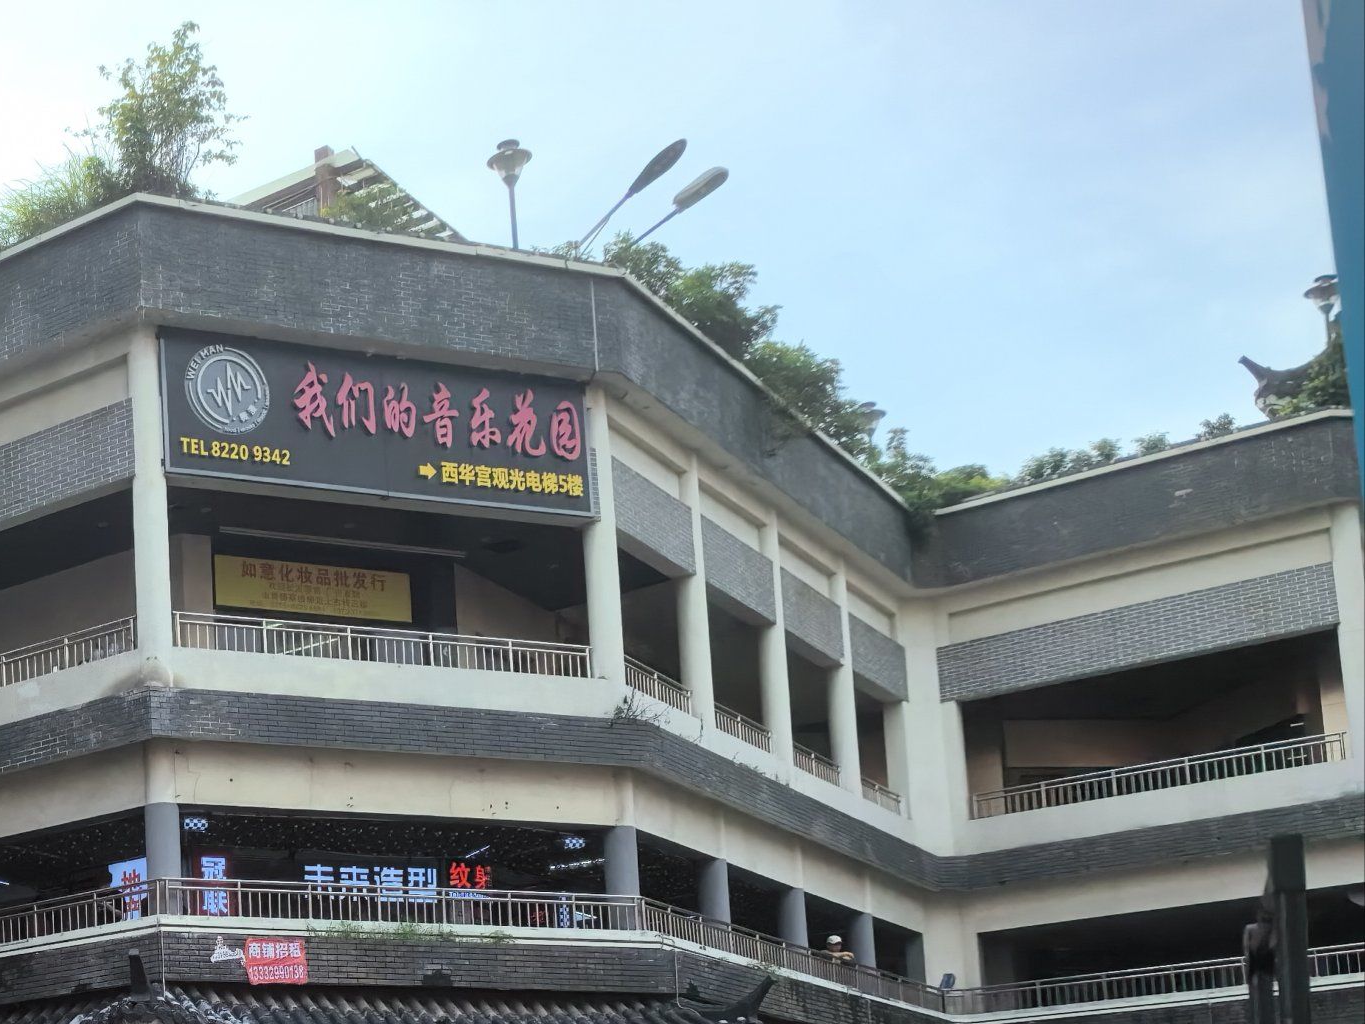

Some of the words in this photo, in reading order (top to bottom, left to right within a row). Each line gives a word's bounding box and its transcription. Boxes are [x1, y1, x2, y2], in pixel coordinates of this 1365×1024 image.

[294, 361, 581, 461] 我们的音乐花园
[180, 437, 209, 456] TEL
[211, 441, 249, 460] 8220
[253, 446, 291, 465] 9342
[440, 461, 584, 497] 西华宫观光电梯5楼
[241, 561, 387, 592] 如意化妆品批发行
[248, 943, 301, 959] 商铺招租
